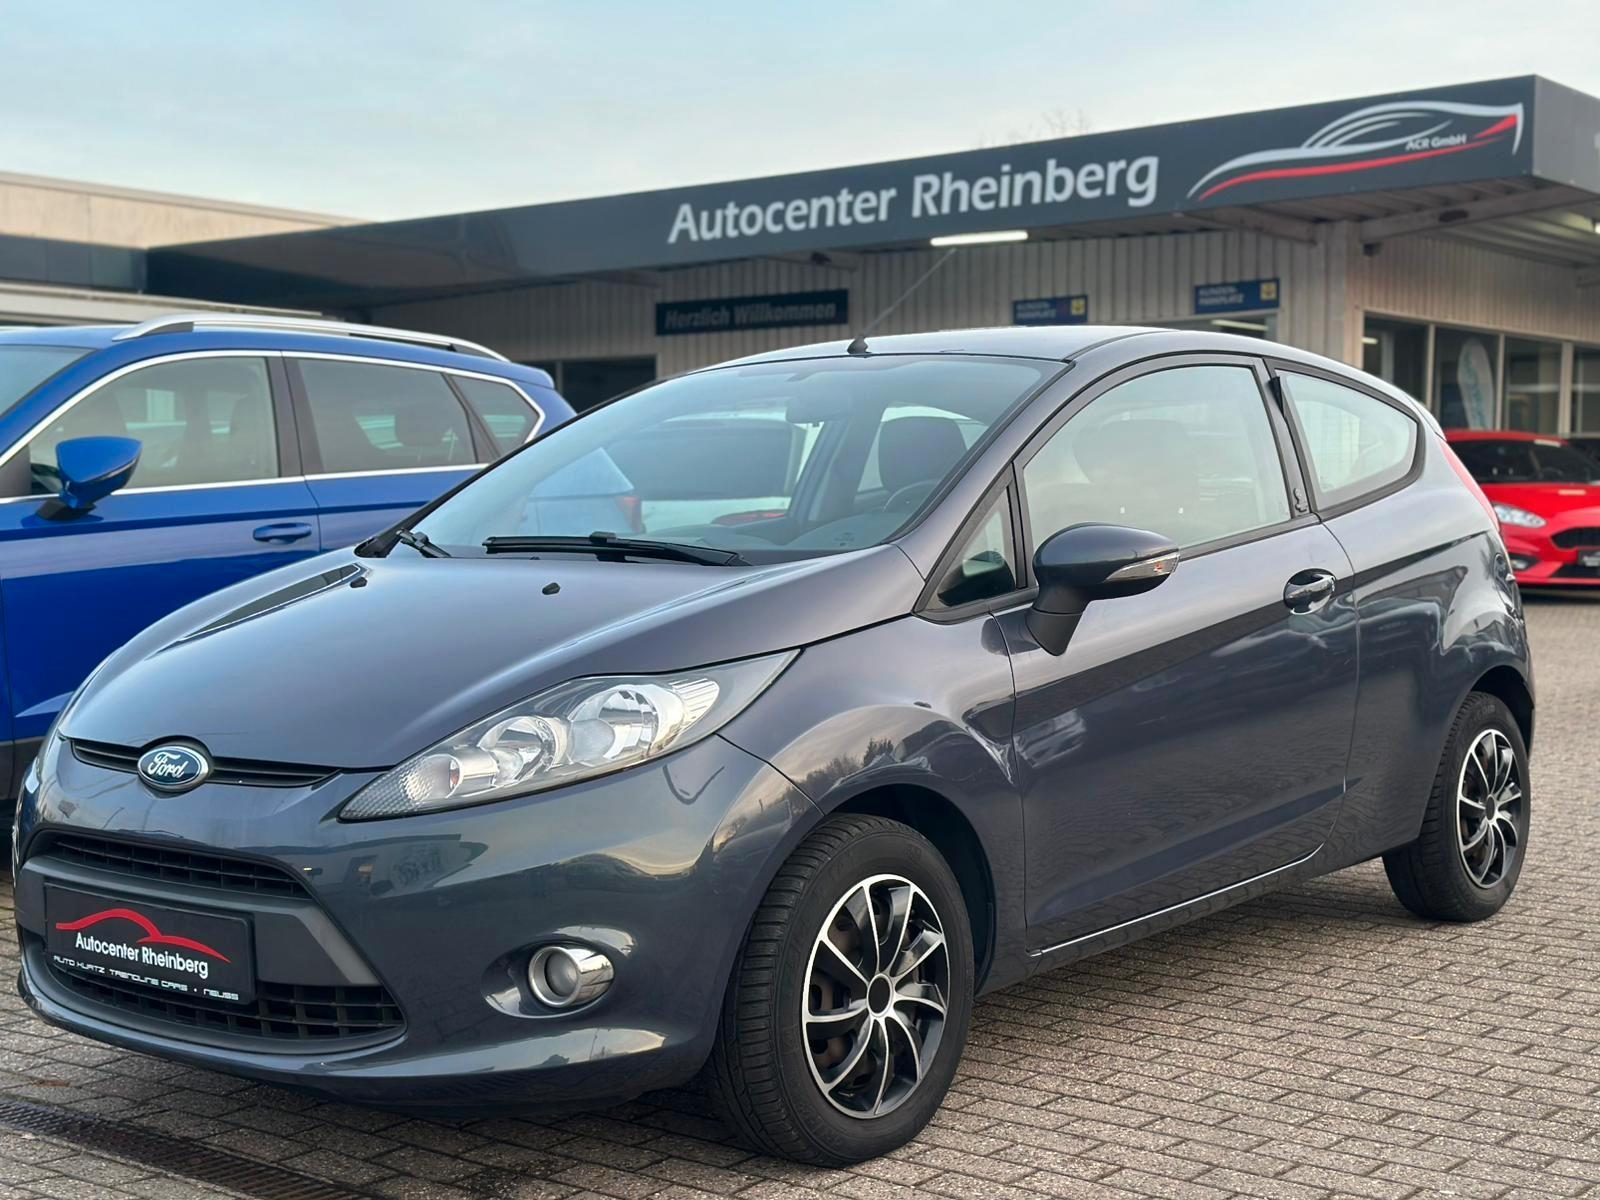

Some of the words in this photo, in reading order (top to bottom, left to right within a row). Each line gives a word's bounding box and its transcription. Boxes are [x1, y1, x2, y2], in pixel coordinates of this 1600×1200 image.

[1405, 138, 1429, 151] ACR
[1431, 133, 1467, 148] GmbH
[666, 186, 897, 244] Autocenter
[911, 156, 1160, 217] Rheinberg
[664, 305, 730, 329] Herzlich
[733, 302, 837, 325] Willkommen
[147, 752, 188, 779] Ford
[75, 932, 139, 961] Autocenter
[141, 947, 209, 979] Rheinberg
